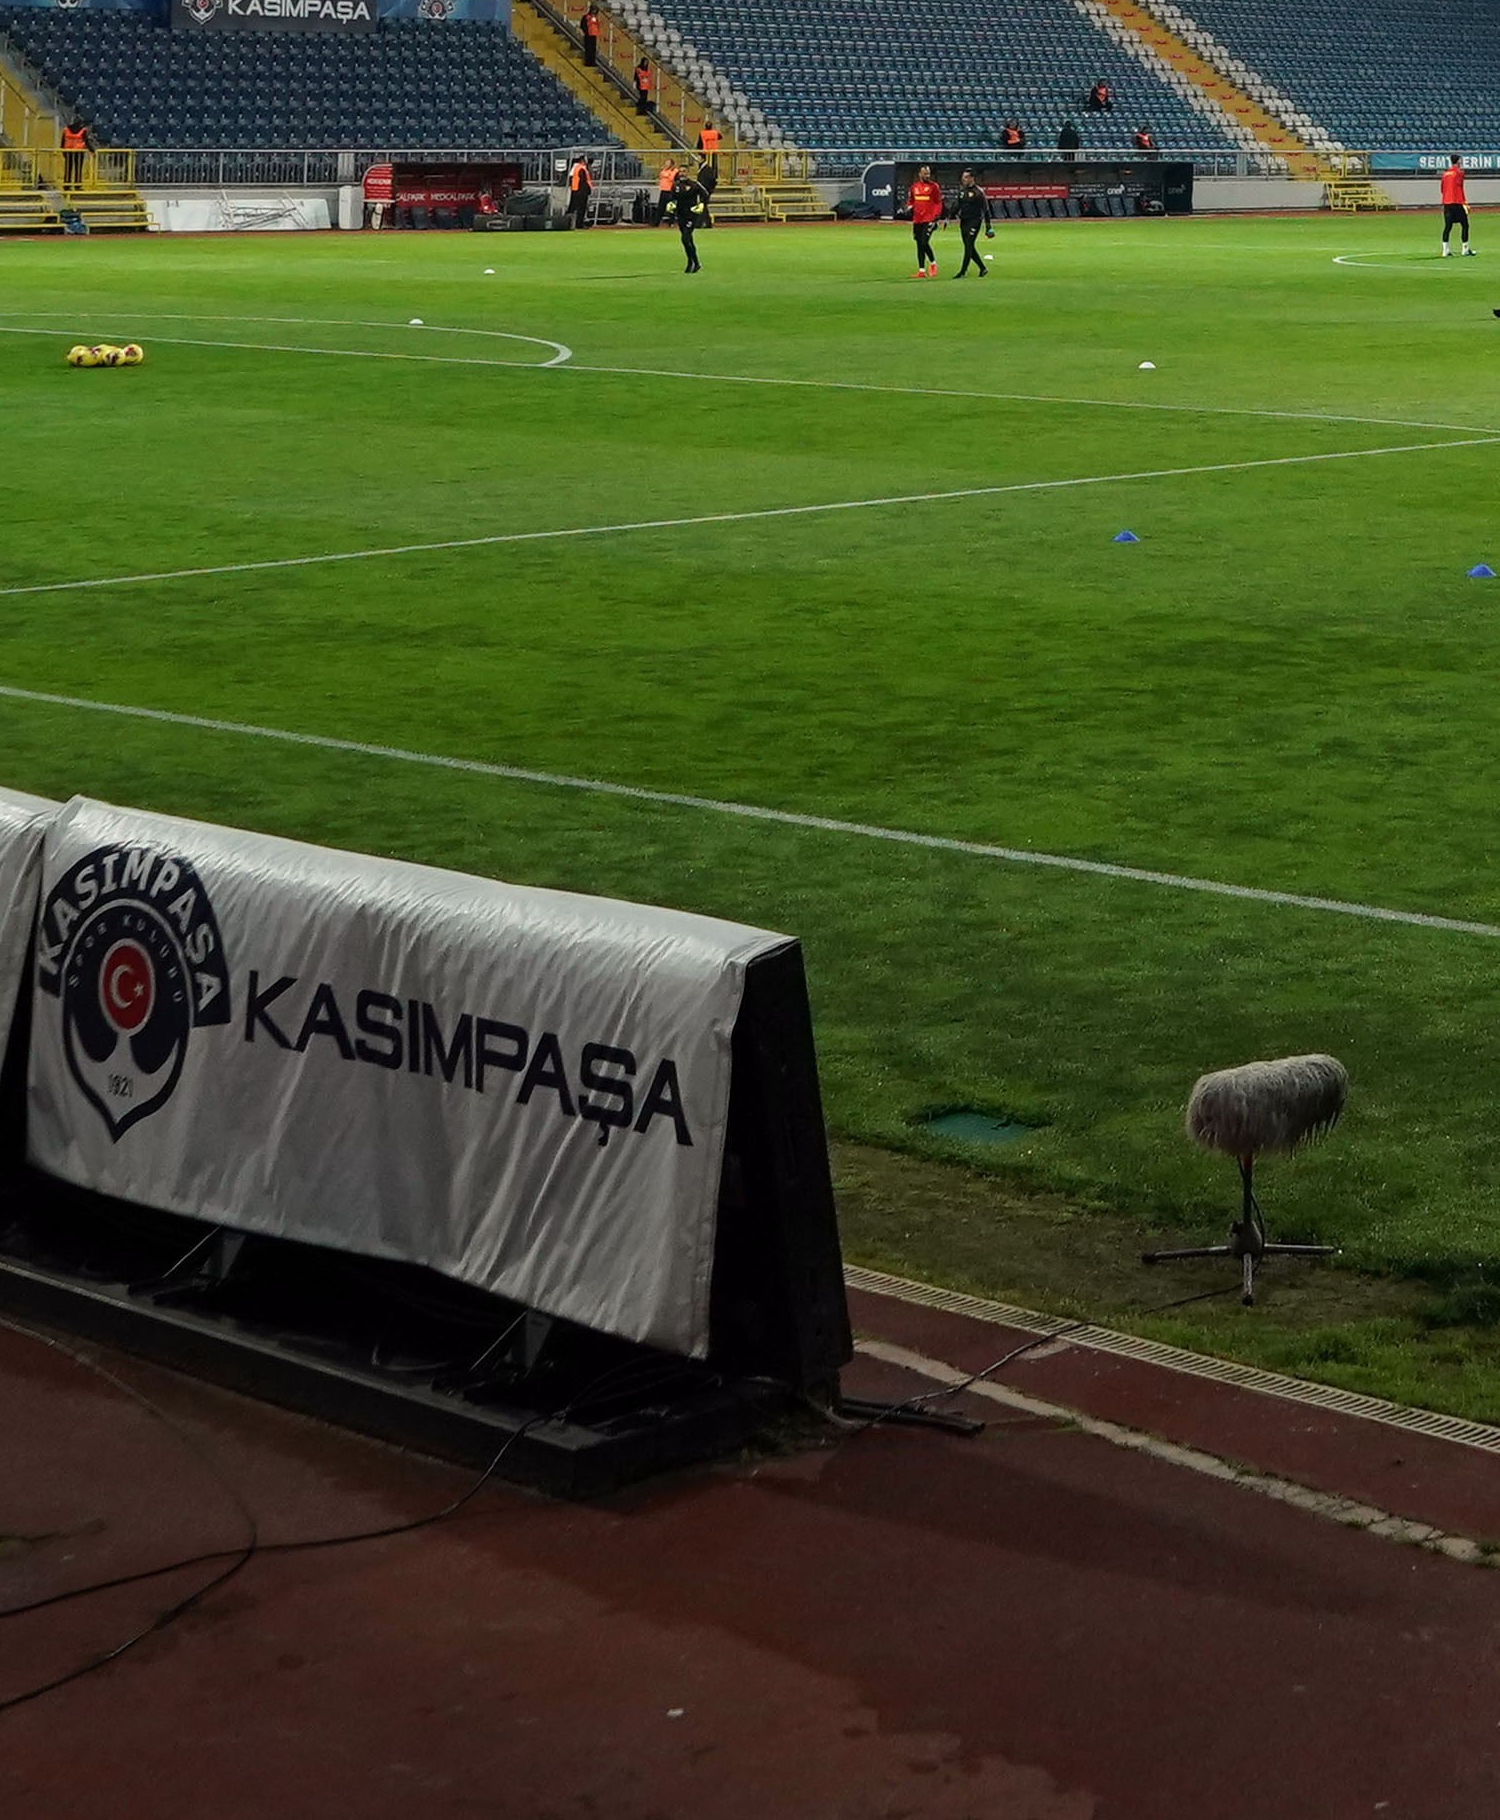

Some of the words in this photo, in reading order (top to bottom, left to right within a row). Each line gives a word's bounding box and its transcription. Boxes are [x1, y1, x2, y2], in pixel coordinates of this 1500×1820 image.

[1419, 155, 1492, 168] SEMTERİN
[37, 847, 222, 1012] KASIMPAŞA
[245, 970, 693, 1147] KASIMPAŞA
